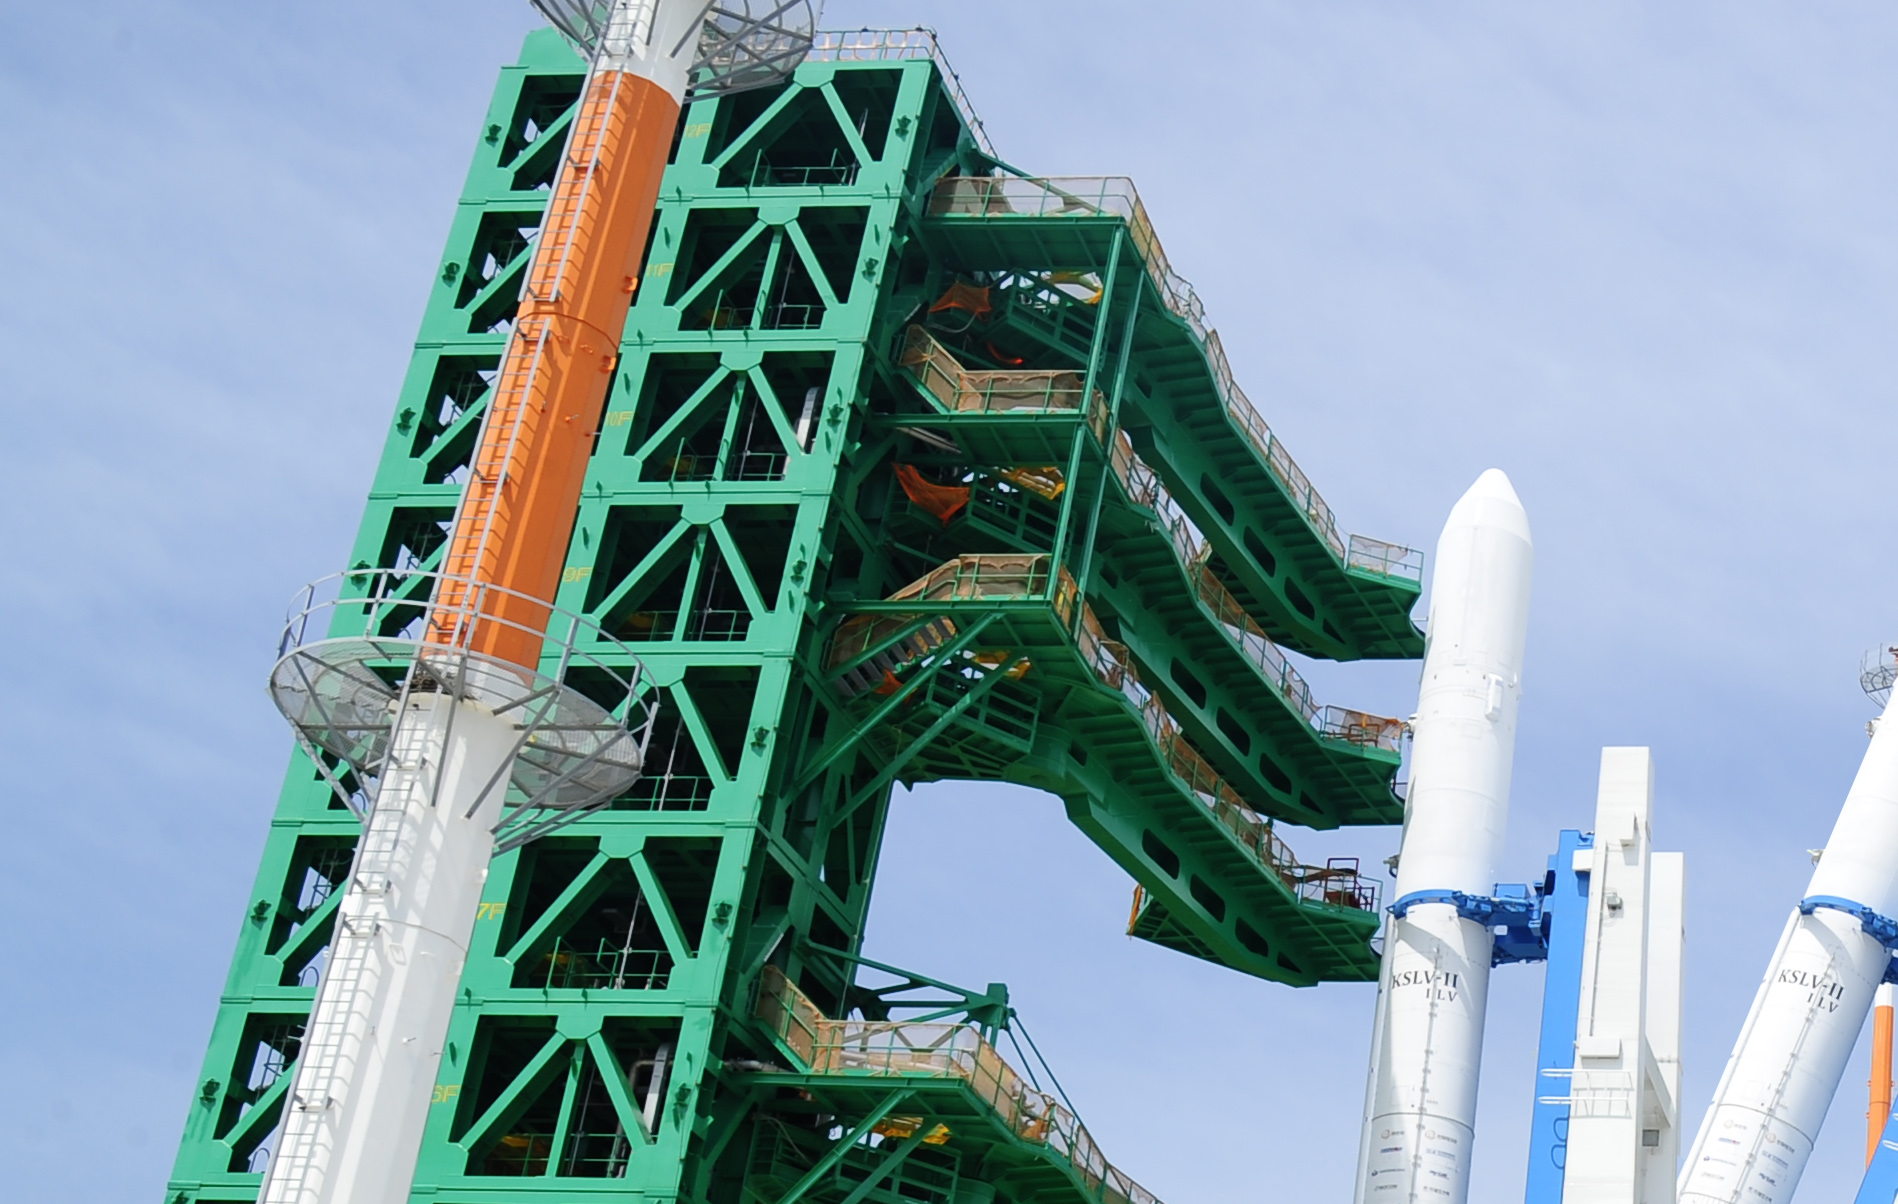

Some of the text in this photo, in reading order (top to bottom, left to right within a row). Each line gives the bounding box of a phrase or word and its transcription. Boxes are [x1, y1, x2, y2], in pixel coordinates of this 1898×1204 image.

[477, 903, 507, 920] 7F
[1392, 970, 1458, 989] KSLV-II
[1778, 969, 1844, 1000] KSLV-II
